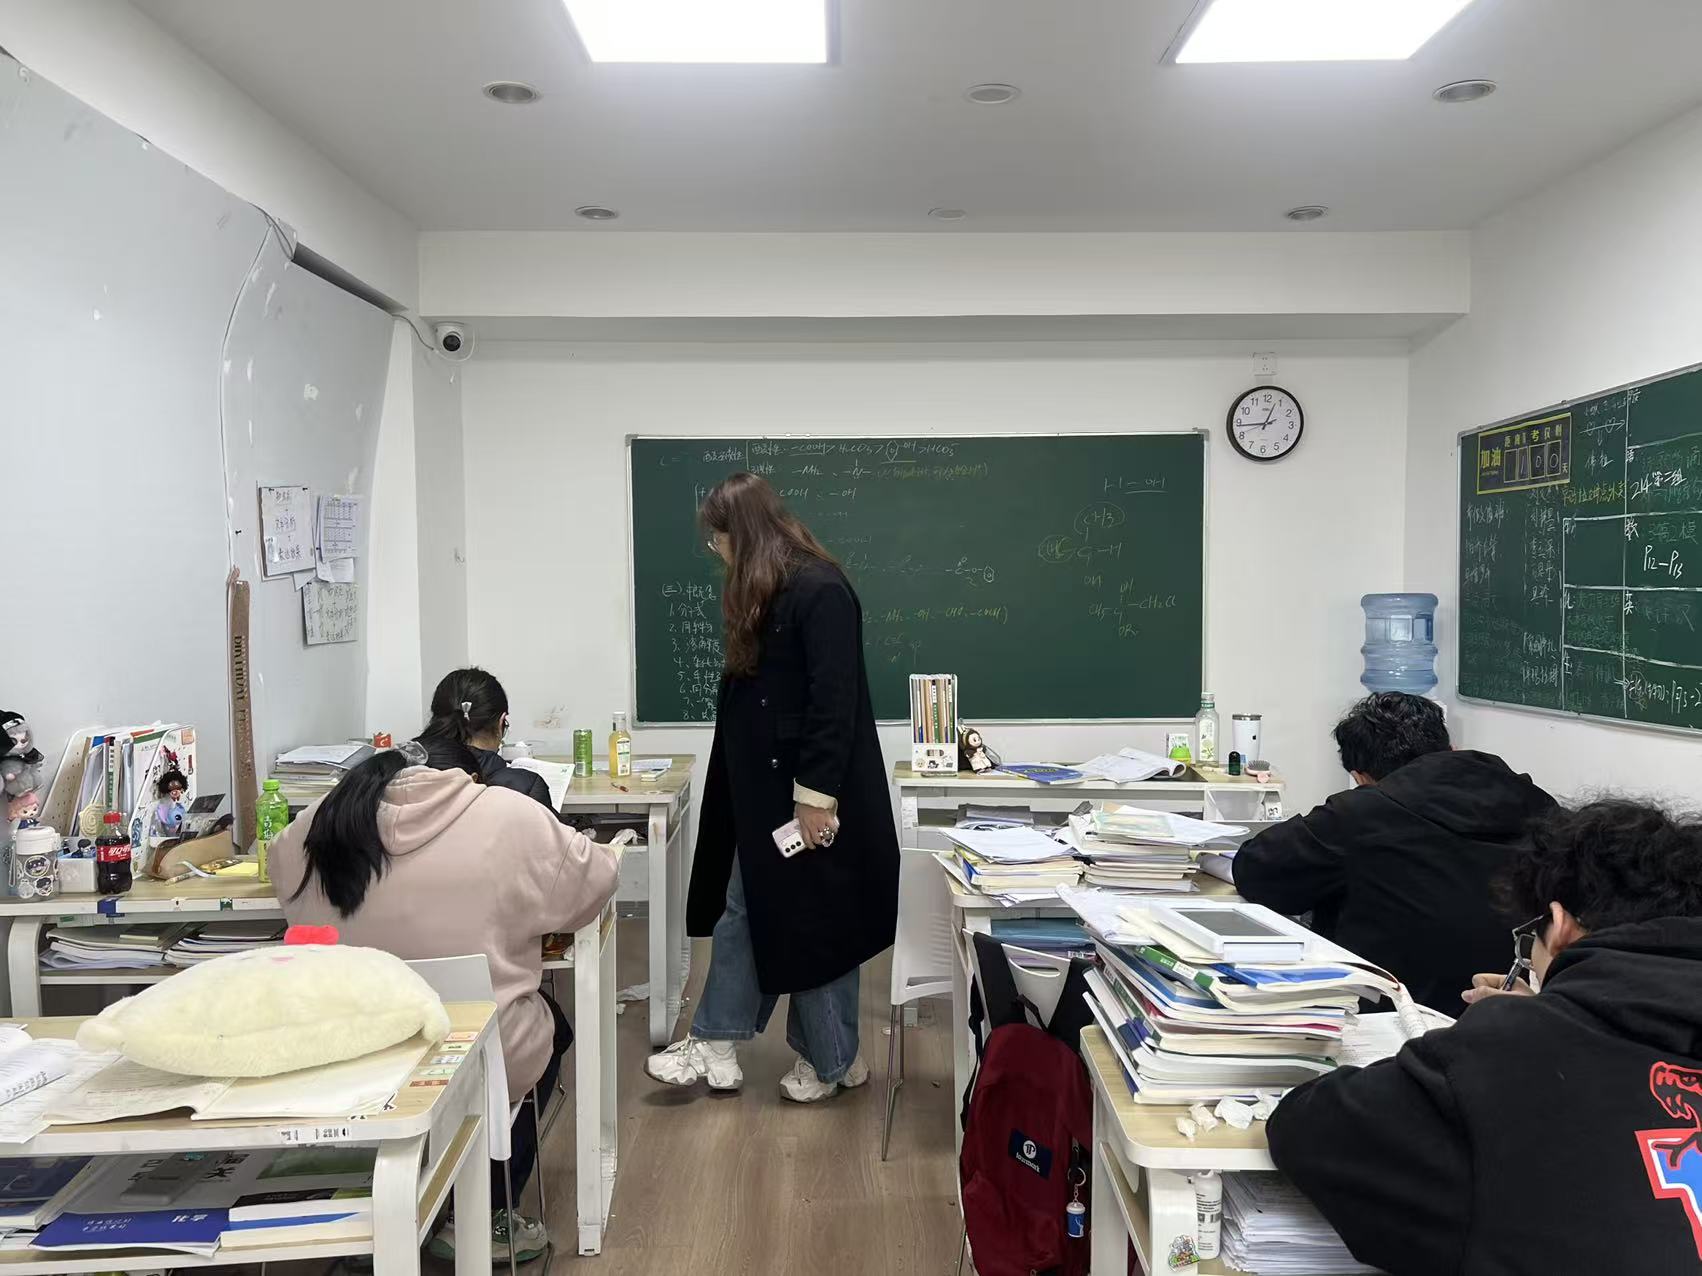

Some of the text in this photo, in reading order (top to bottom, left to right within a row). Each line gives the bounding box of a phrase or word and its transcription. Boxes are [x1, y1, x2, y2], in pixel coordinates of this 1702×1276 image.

[1251, 398, 1259, 406] 11
[1263, 394, 1272, 403] 12
[1278, 399, 1282, 407] 1
[1241, 407, 1250, 415] 10
[1286, 409, 1292, 417] 2
[1236, 418, 1242, 426] 9
[1288, 421, 1294, 429] 3
[1239, 432, 1245, 440] 8
[1249, 441, 1255, 449] 7
[1260, 445, 1266, 453] 6
[1274, 442, 1280, 450] 5
[1481, 446, 1502, 470] 加油
